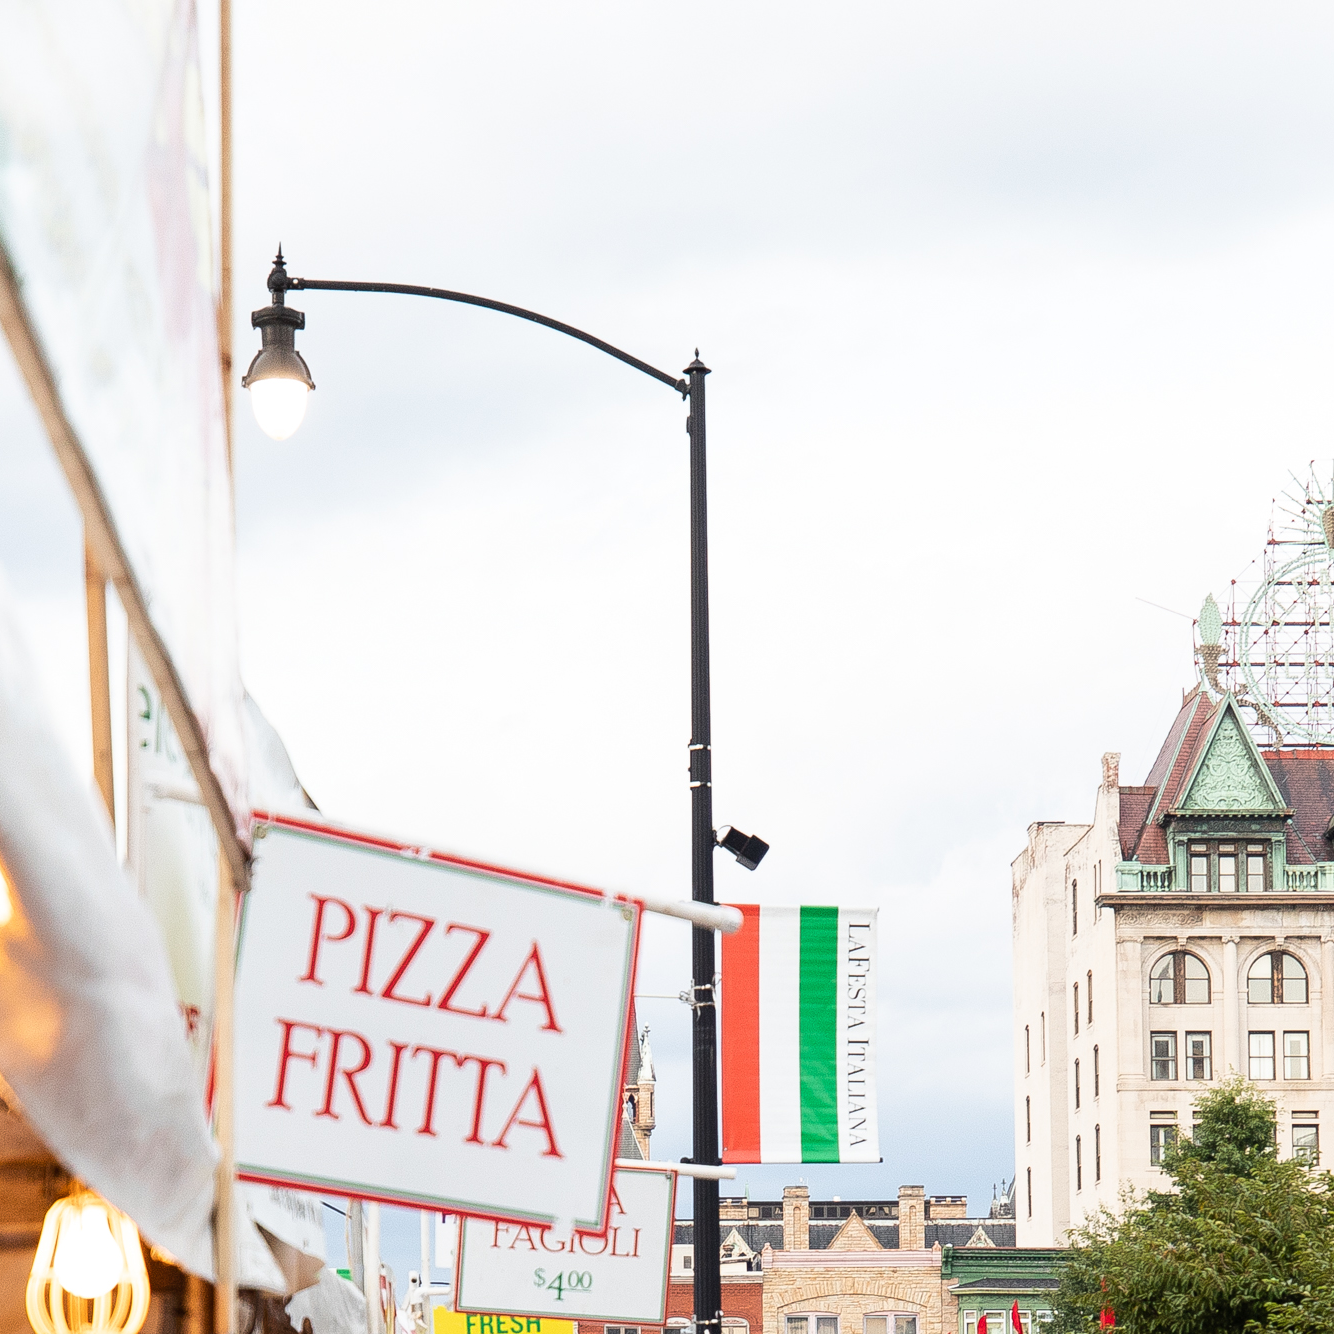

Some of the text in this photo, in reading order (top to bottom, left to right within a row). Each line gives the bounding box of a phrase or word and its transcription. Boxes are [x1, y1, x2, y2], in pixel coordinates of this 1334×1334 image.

[296, 891, 564, 1034] PIZZA
[266, 1015, 565, 1160] FRITTA
[847, 1037, 870, 1147] ITALIANA
[490, 1220, 642, 1258] FAGIOLI
